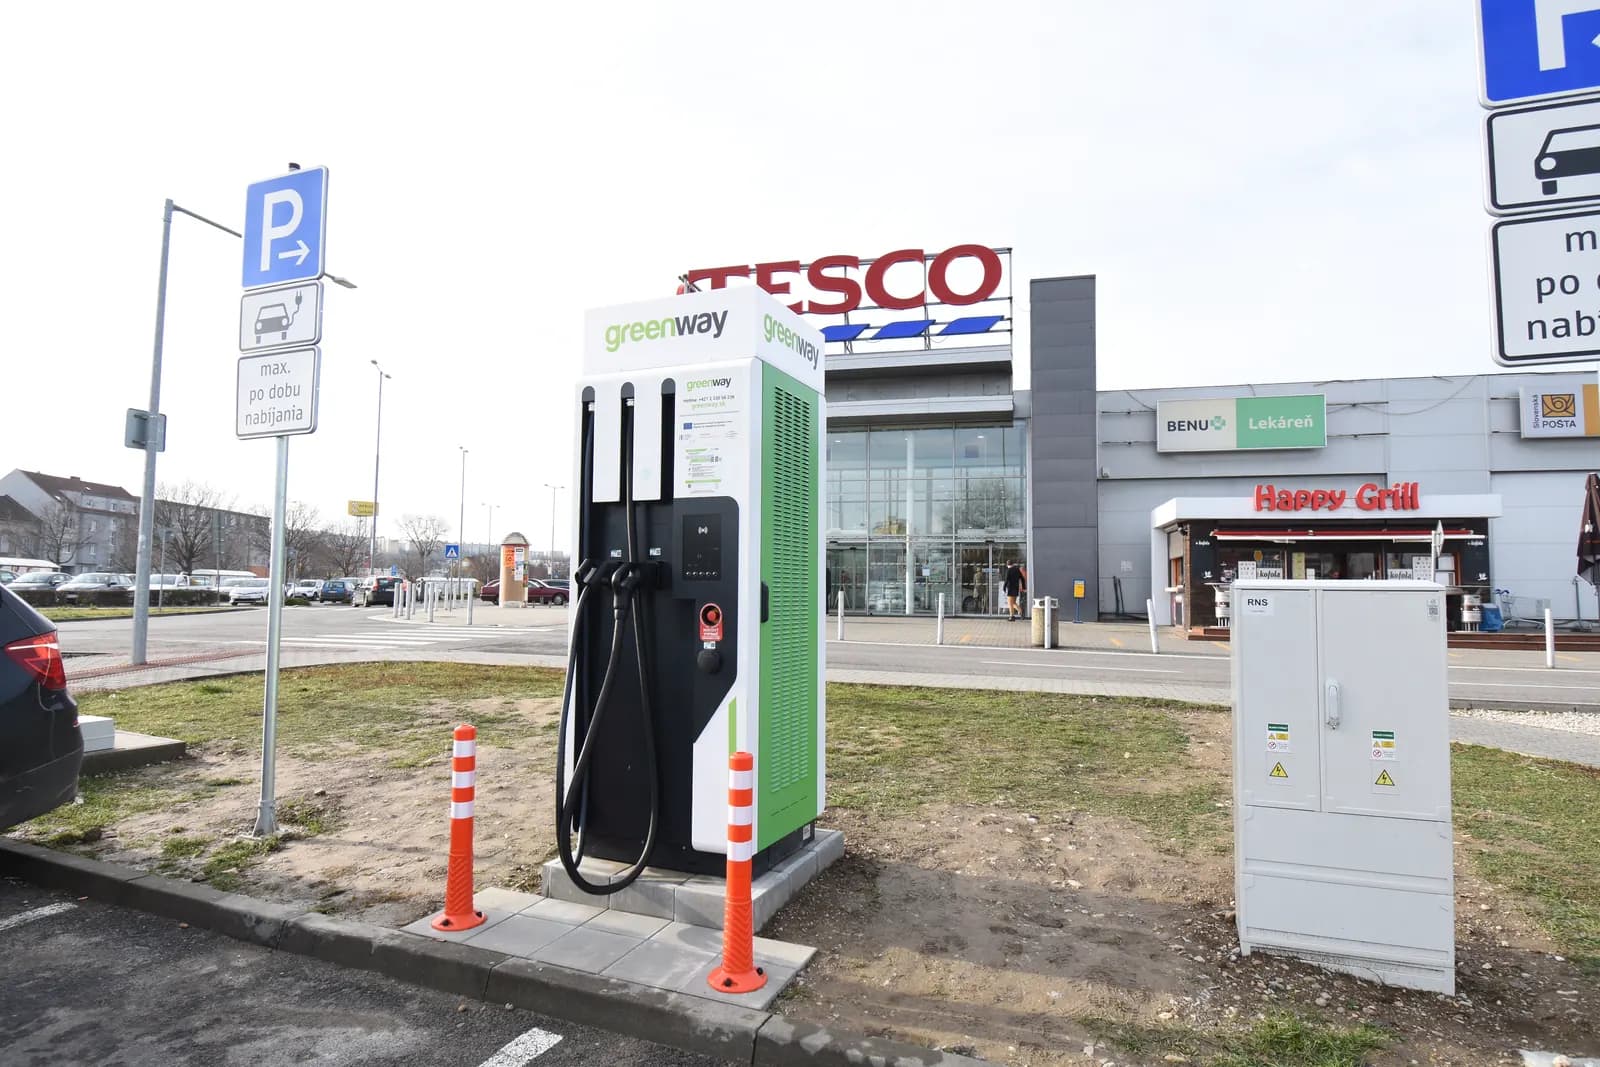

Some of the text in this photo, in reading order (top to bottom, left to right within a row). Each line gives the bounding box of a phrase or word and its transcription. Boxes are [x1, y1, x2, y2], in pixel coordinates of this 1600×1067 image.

[259, 188, 304, 272] P
[688, 243, 1002, 316] TESCO
[1536, 274, 1580, 304] po
[605, 309, 729, 352] greenway
[763, 313, 819, 370] greenway
[260, 361, 291, 376] max.
[249, 382, 301, 405] po dobu
[686, 377, 732, 392] greenway
[244, 405, 304, 427] nabíjania
[1167, 414, 1314, 432] BENU Lekáreň
[1542, 419, 1577, 429] POŠTA
[1254, 481, 1420, 511] Happy Grill
[1247, 598, 1269, 607] RNS
